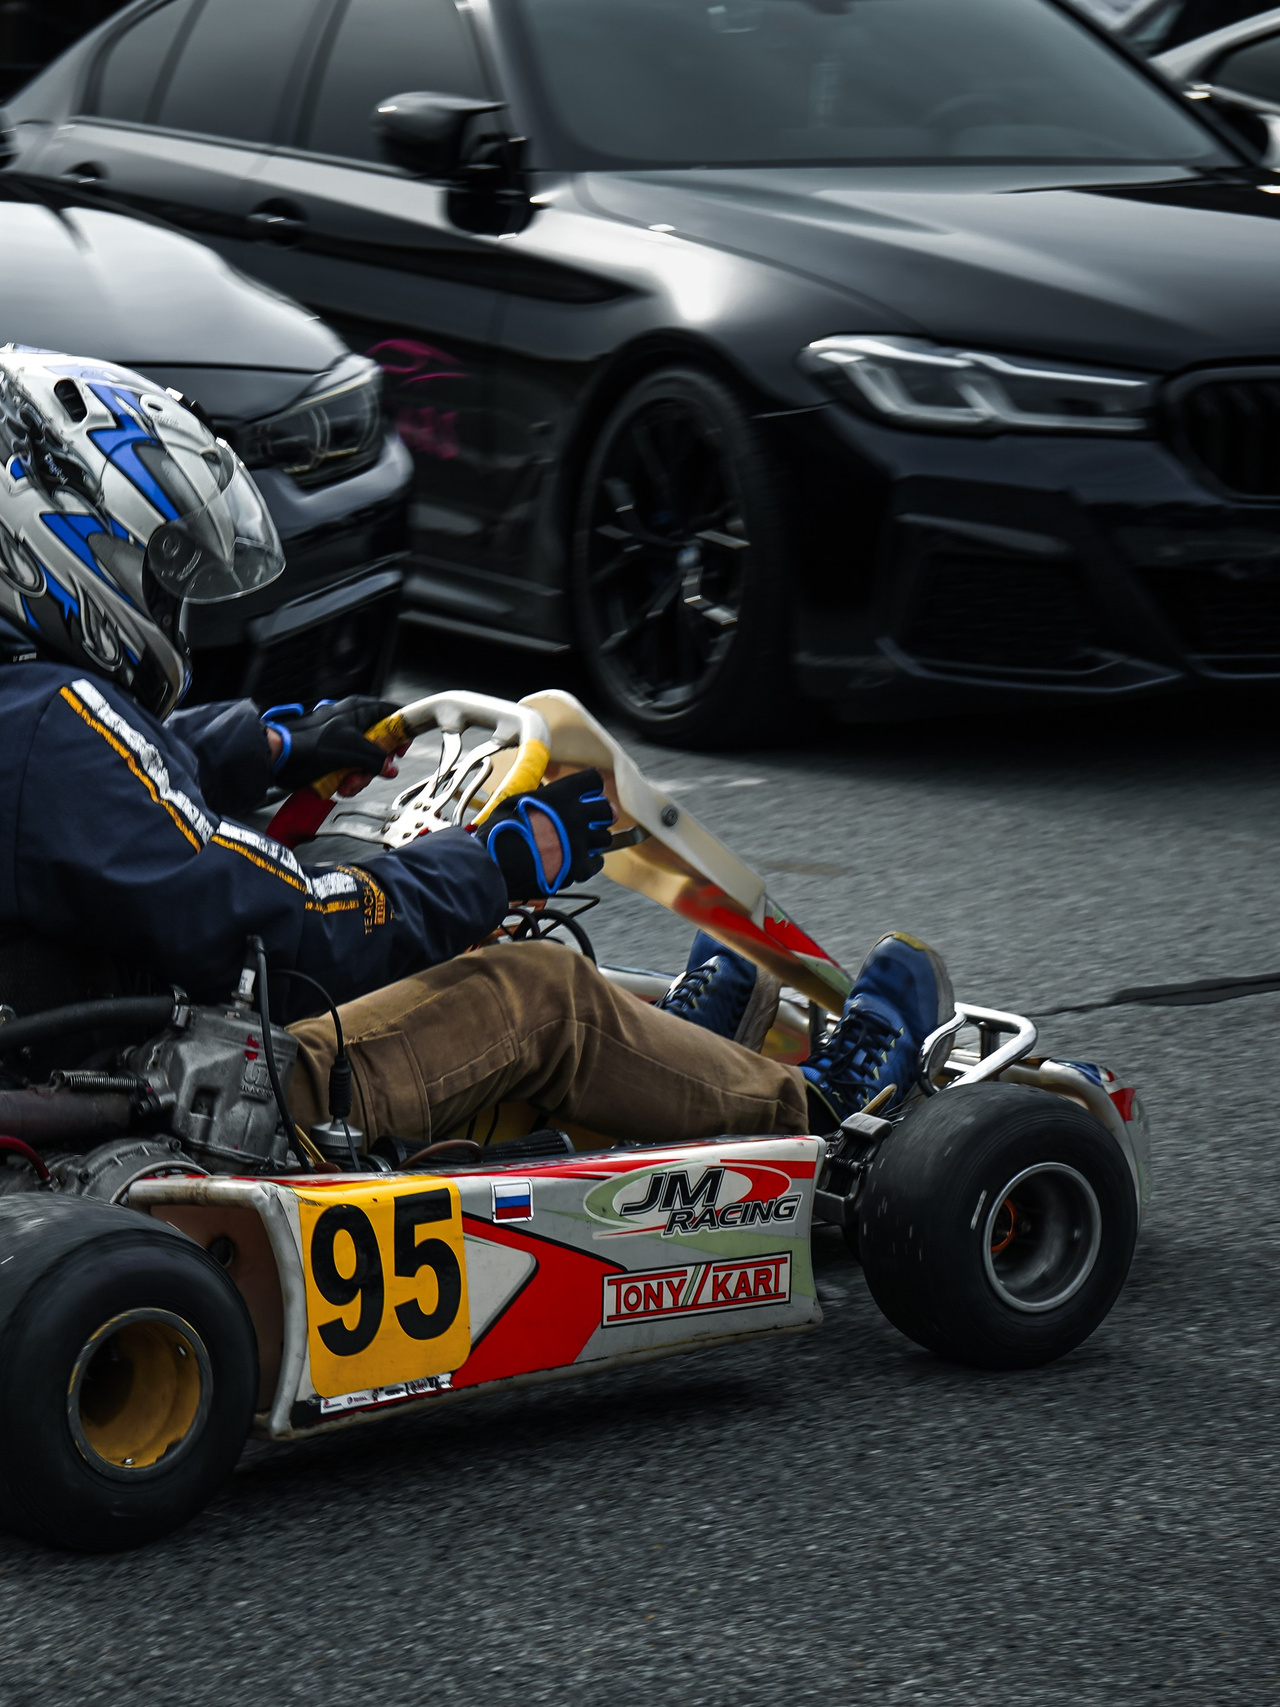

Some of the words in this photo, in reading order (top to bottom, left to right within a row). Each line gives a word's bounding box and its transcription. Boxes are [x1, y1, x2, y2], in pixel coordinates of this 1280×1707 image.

[619, 1166, 727, 1217] JM
[663, 1194, 802, 1236] RACING
[310, 1187, 462, 1357] 95
[607, 1269, 688, 1314] TONY
[711, 1256, 788, 1301] KART
